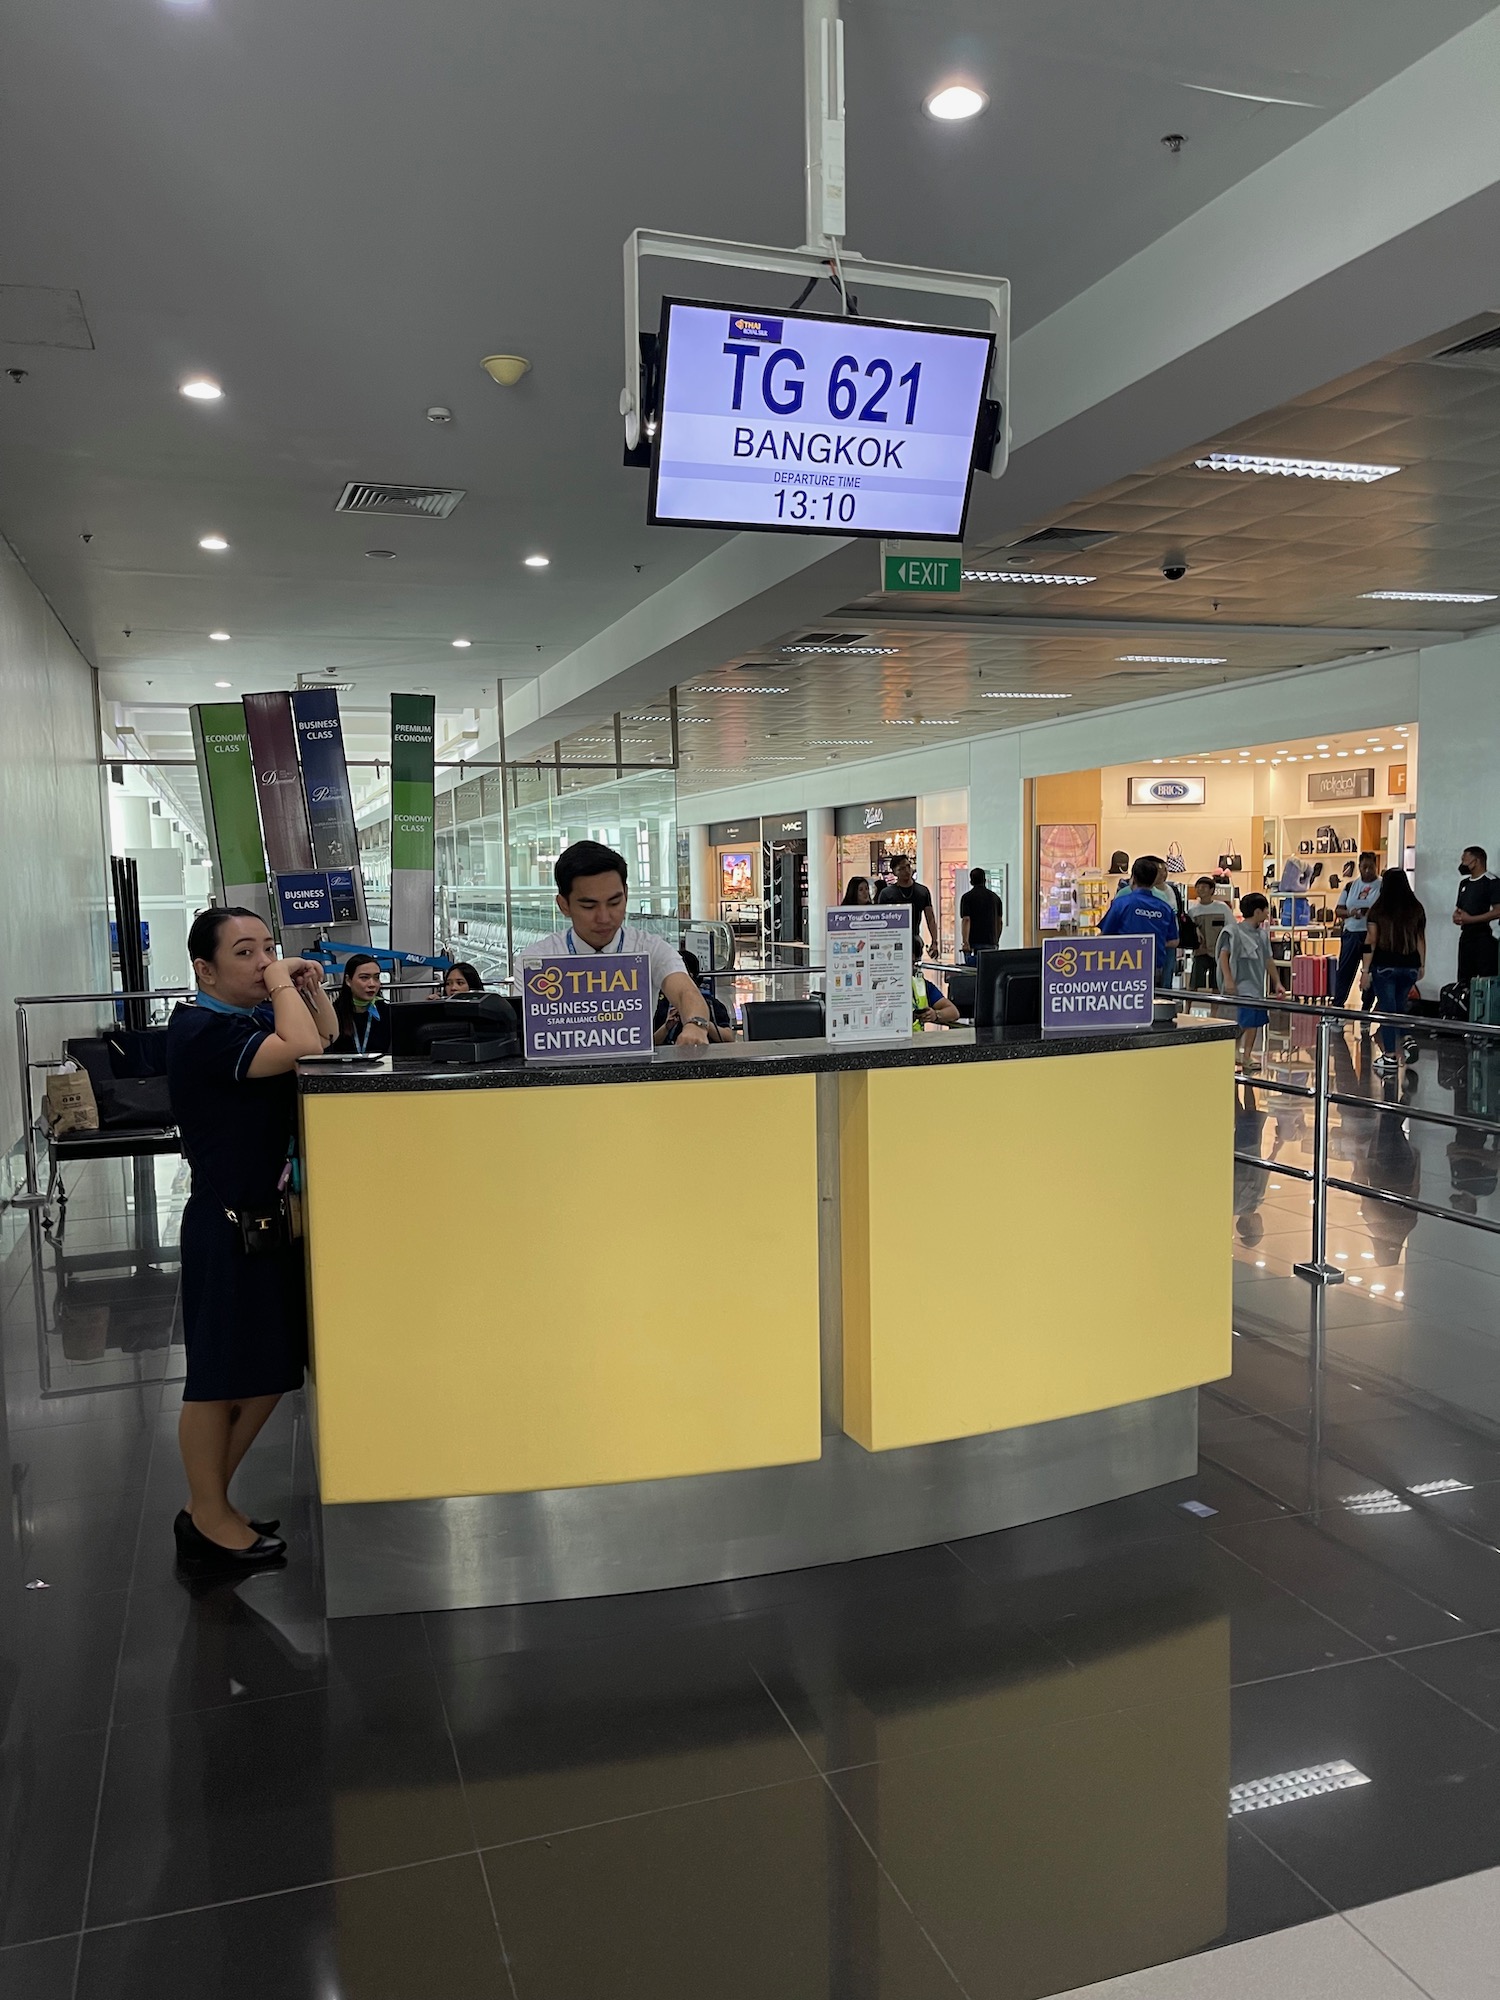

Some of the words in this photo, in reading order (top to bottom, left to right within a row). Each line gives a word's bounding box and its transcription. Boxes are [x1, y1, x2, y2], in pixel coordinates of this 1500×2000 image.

[743, 321, 761, 330] THAI
[723, 343, 806, 415] TG
[828, 355, 922, 425] 621
[733, 427, 906, 469] BANGKOK
[774, 472, 835, 487] DEPARTURE
[837, 475, 861, 488] TIME
[774, 489, 855, 522] 13:10
[909, 561, 949, 586] EXIT
[299, 718, 338, 730] BUSINESS
[395, 724, 431, 733] PREMIUM
[205, 733, 246, 743] ECONOMY
[306, 731, 333, 741] CLASS
[394, 734, 433, 743] ECONOMY
[214, 744, 240, 753] CLASS
[394, 814, 432, 823] ECONOMY
[400, 823, 425, 833] CLASS
[284, 889, 325, 899] BUSINESS
[293, 900, 320, 909] CLASS
[834, 914, 847, 922] For
[864, 913, 880, 921] Own
[881, 912, 902, 921] Safety
[405, 954, 420, 963] ANA
[1080, 949, 1143, 971] THAI
[565, 968, 639, 994] THAI
[1049, 981, 1108, 994] ECONOMY
[1111, 980, 1147, 992] CLASS
[530, 1000, 598, 1016] BUSINESS
[602, 998, 643, 1012] CLASS
[1051, 994, 1145, 1013] ENTRANCE
[547, 1017, 564, 1026] STAR
[566, 1015, 597, 1024] ALLIANCE
[597, 1011, 624, 1022] GOLD
[533, 1026, 641, 1050] ENTRANCE
